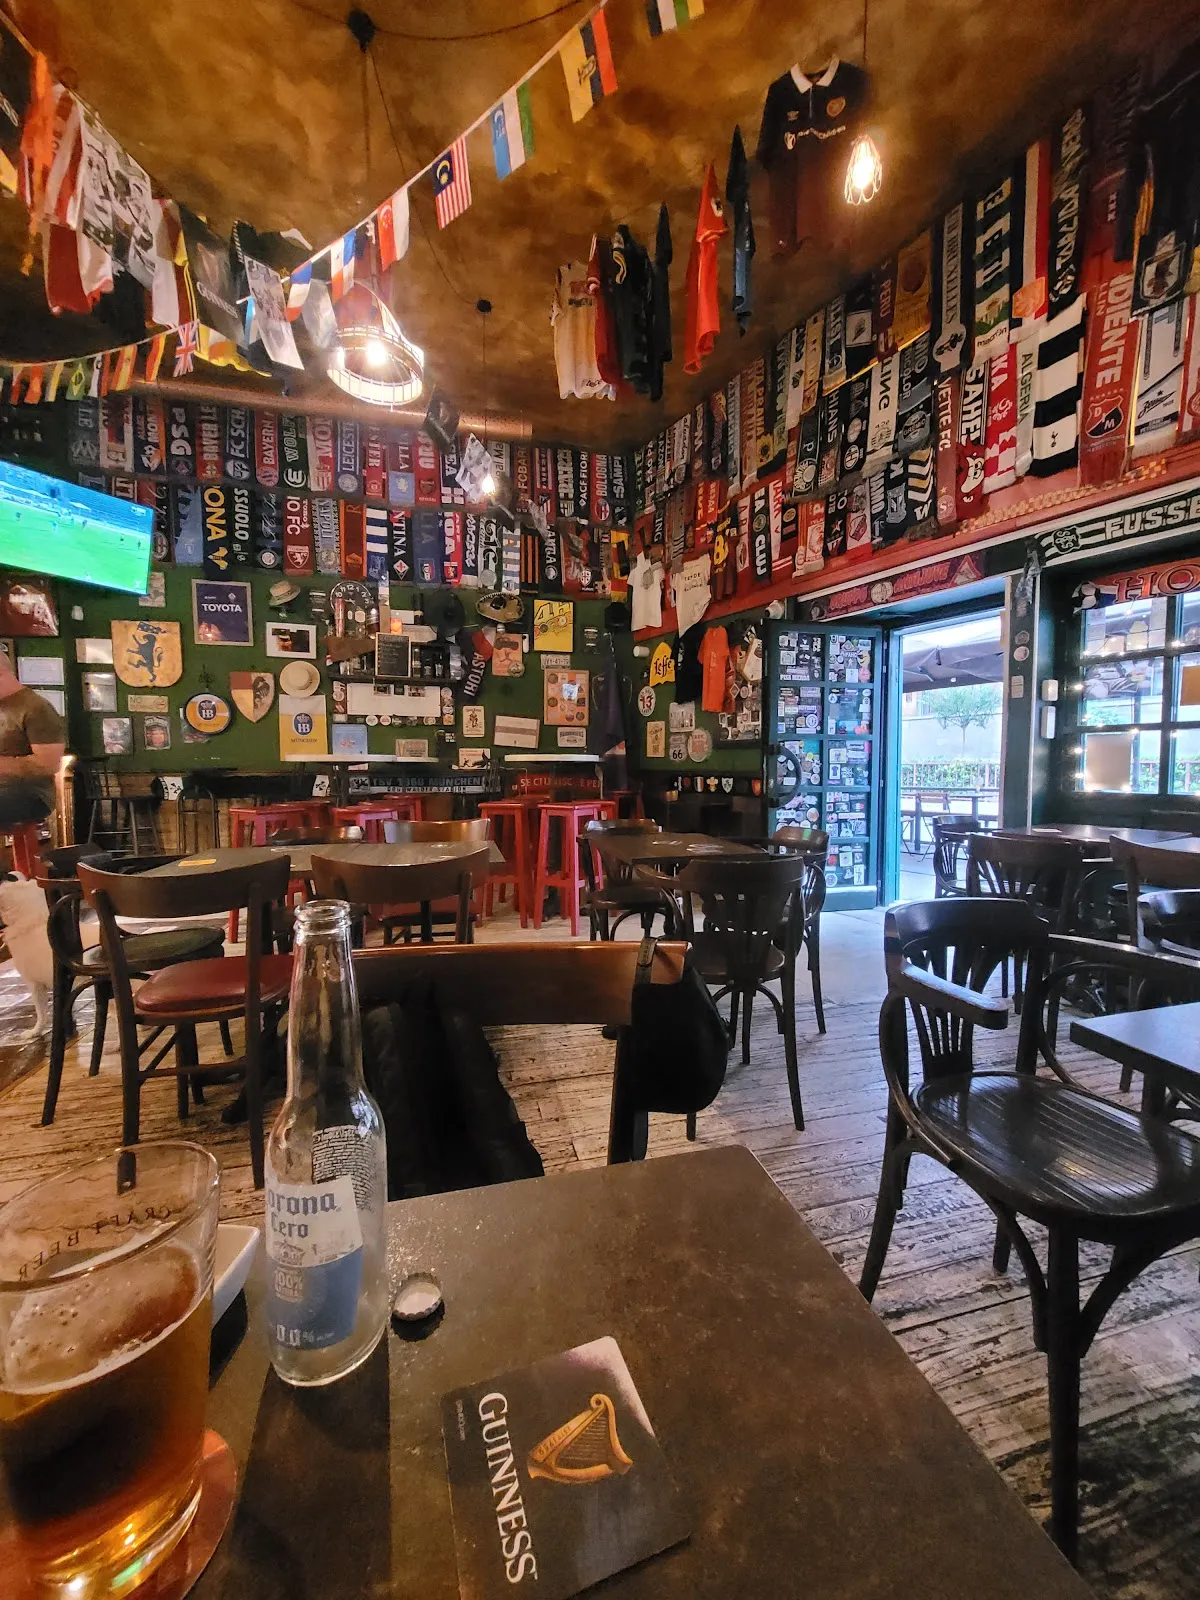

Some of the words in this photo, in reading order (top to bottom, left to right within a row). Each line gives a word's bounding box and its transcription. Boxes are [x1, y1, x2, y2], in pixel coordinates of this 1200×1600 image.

[880, 279, 892, 317] PERU
[976, 326, 1008, 348] macron
[1016, 352, 1034, 425] ALGERIA
[170, 406, 192, 457] PSG
[260, 419, 275, 465] BAYERN
[938, 428, 952, 452] FC
[230, 438, 247, 459] FC
[579, 480, 588, 500] ACF
[595, 454, 607, 497] BOLOGNA
[287, 516, 301, 536] FC
[754, 534, 768, 577] CLUJ
[201, 602, 243, 613] TOYOTA
[463, 651, 487, 698] ASTORI
[672, 749, 683, 760] 66
[266, 1189, 337, 1218] orona
[270, 1212, 309, 1239] Cero
[478, 1392, 538, 1584] GUINNESS
